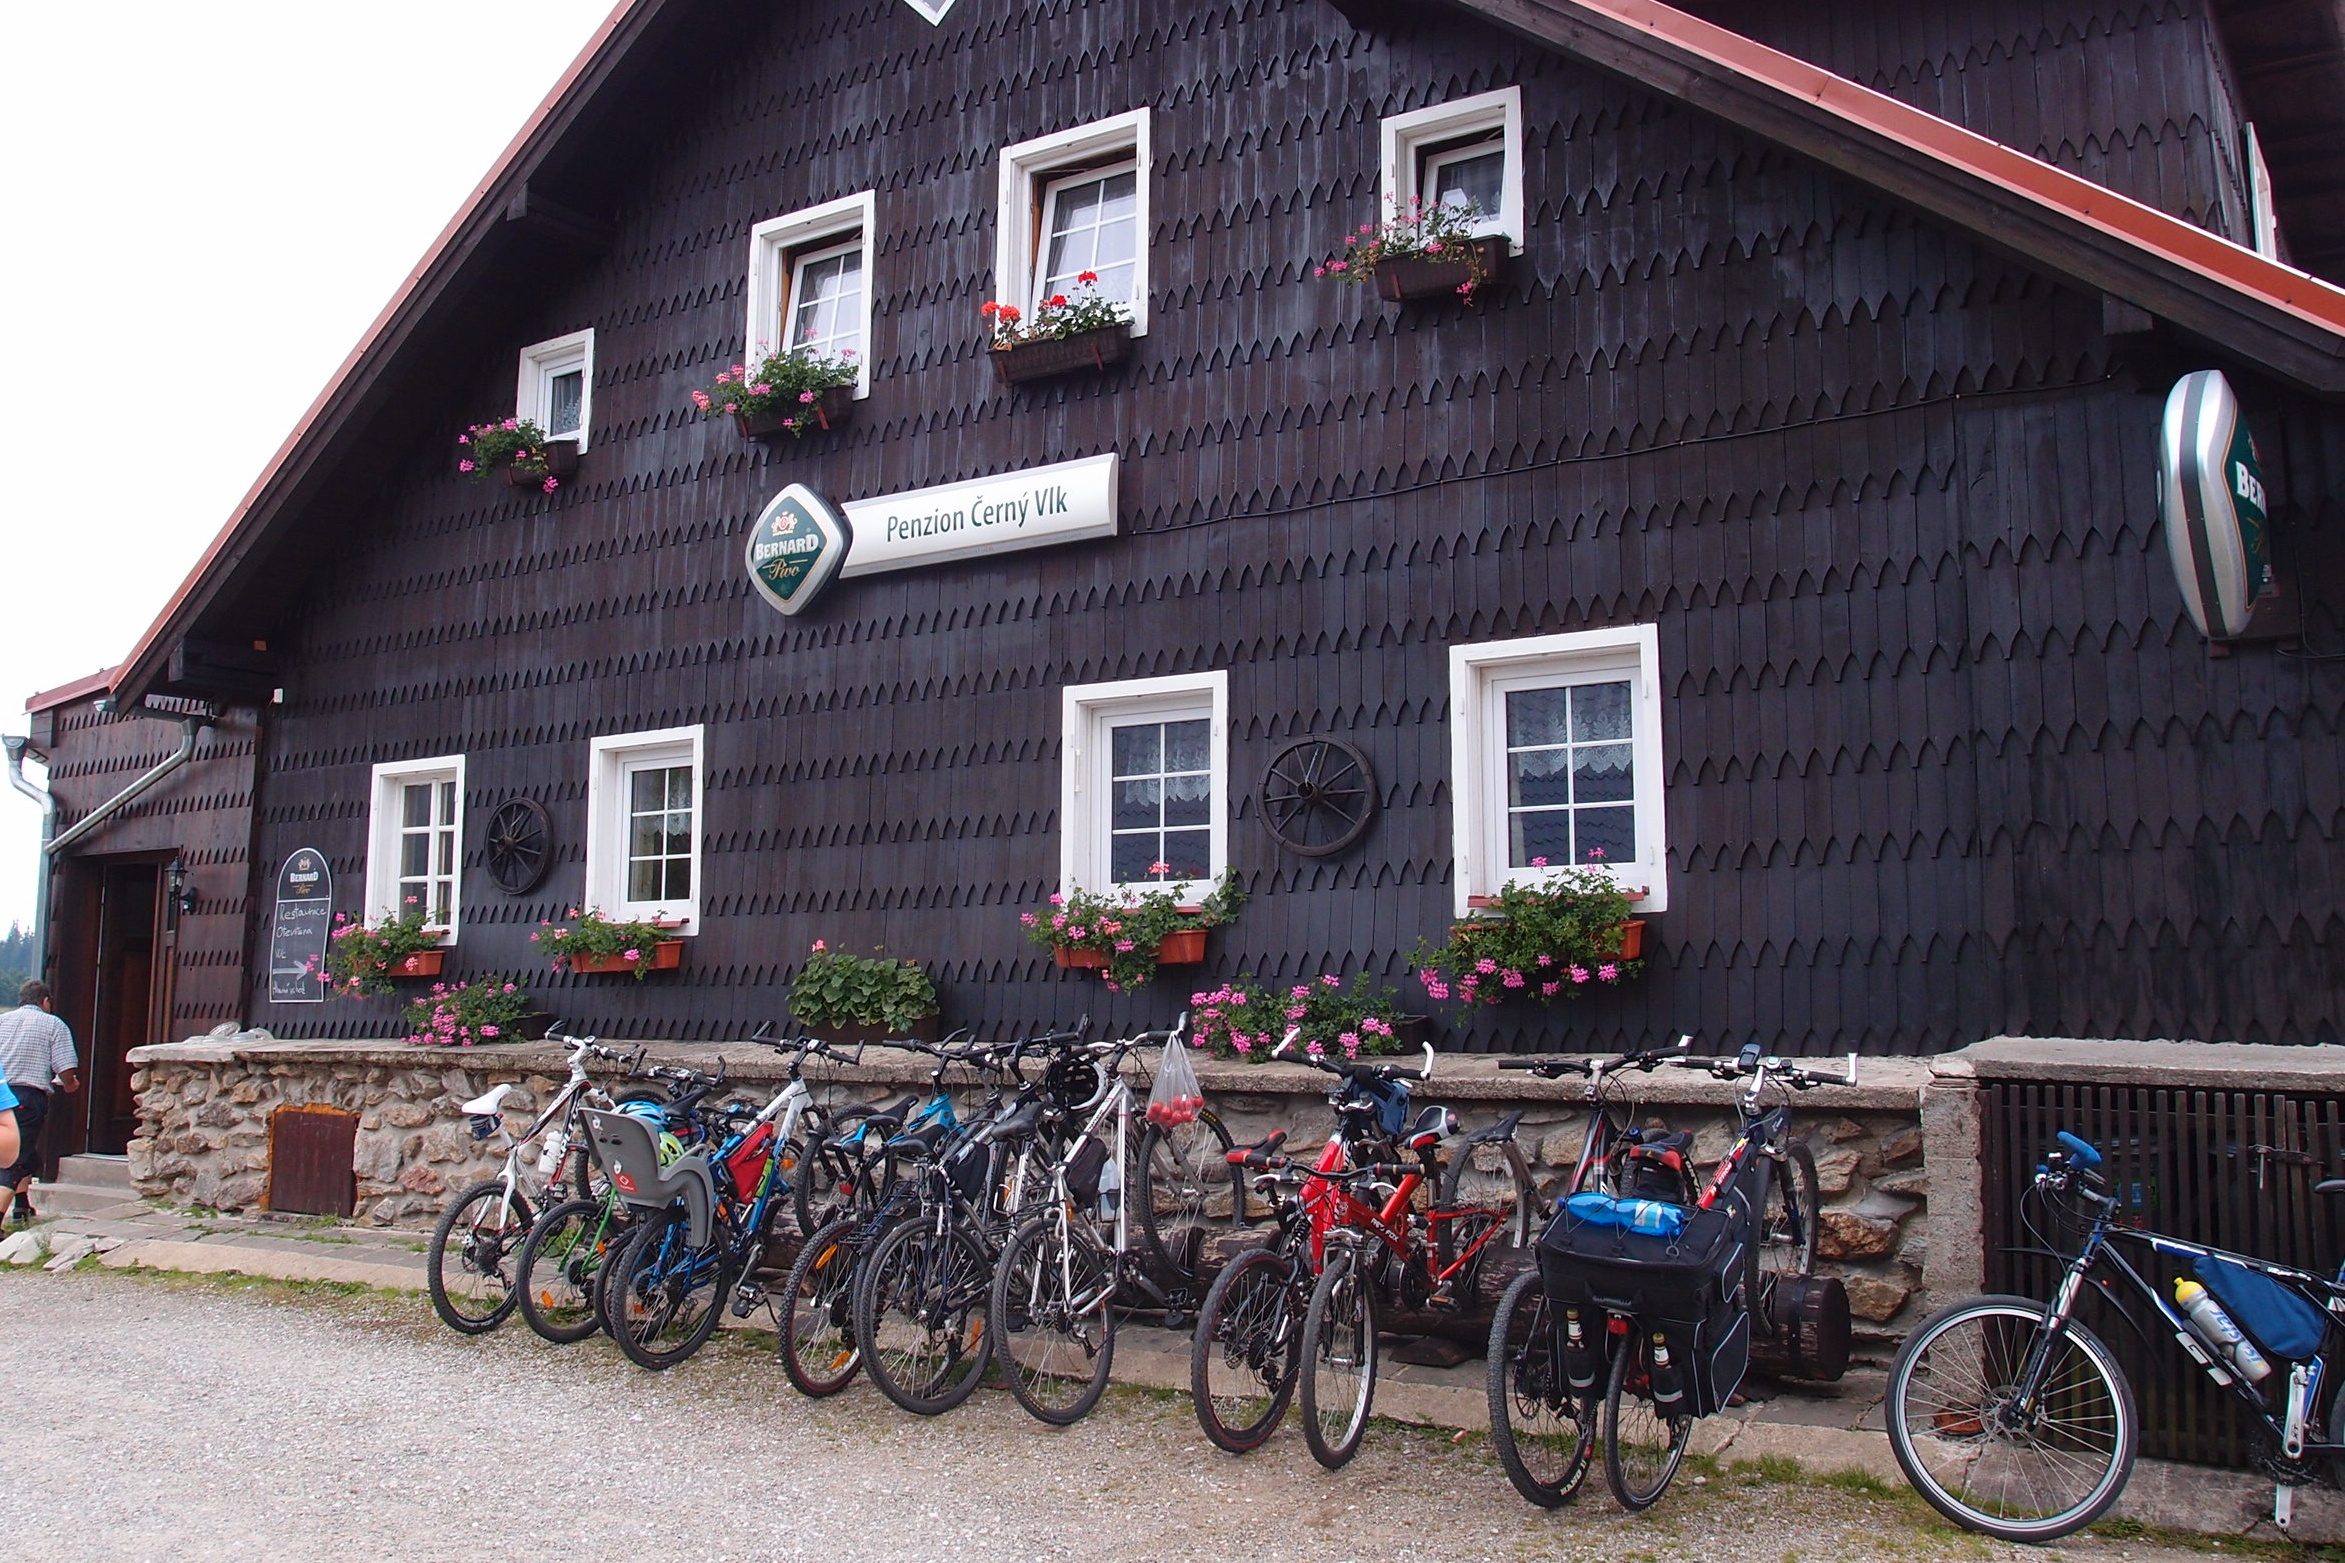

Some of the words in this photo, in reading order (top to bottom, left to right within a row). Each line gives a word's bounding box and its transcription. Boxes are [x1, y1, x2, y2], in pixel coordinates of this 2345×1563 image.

[887, 508, 964, 542] Penzion
[971, 491, 1029, 528] Černý
[1035, 485, 1067, 517] Vlk
[754, 534, 819, 561] BERNARD
[768, 558, 800, 580] Pivo
[290, 871, 319, 883] BERNARD
[1385, 1229, 1399, 1243] FOX
